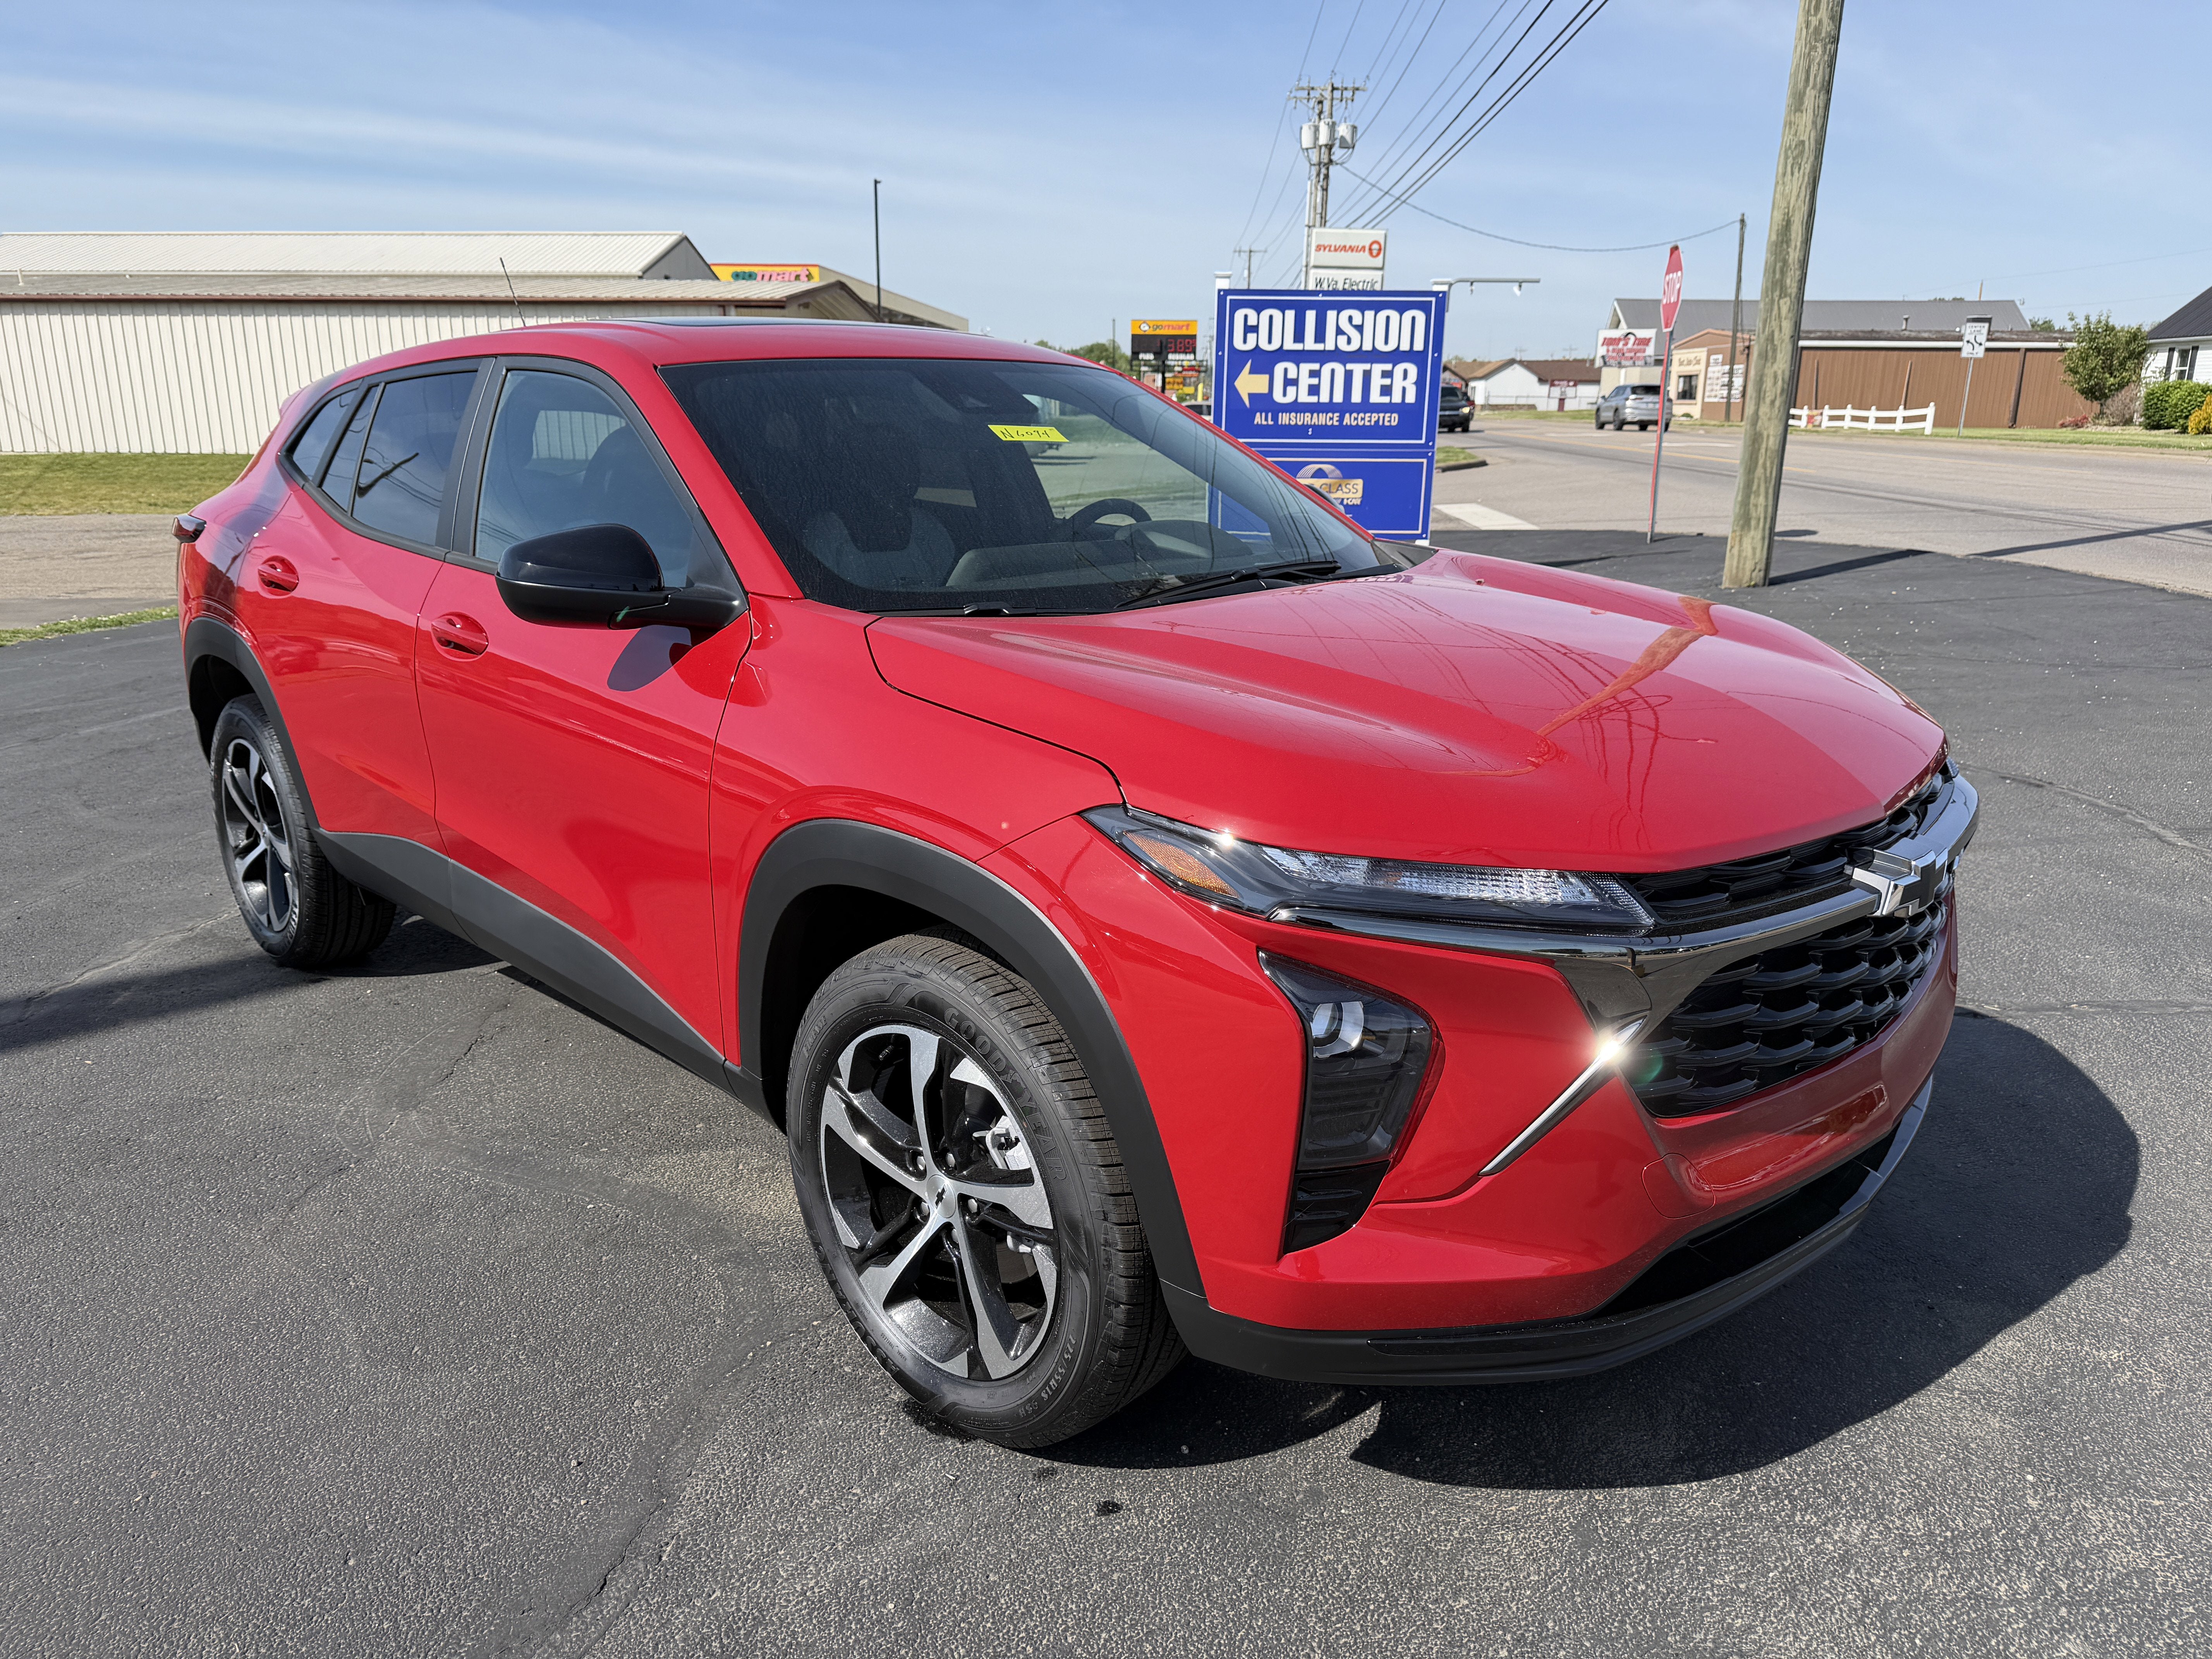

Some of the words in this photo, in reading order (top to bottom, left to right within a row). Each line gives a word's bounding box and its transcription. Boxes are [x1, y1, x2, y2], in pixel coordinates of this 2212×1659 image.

[1315, 244, 1366, 253] SYLVANIA
[1343, 277, 1378, 290] Electric
[1662, 271, 1681, 304] STOP
[1152, 323, 1190, 331] gomart
[1233, 308, 1426, 352] COLLISION
[1273, 361, 1418, 404] CENTER
[1254, 412, 1274, 425] ALL
[1278, 412, 1340, 426] INSURANCE
[1343, 413, 1399, 426] ACCEPTED
[1320, 483, 1358, 495] CLASS
[944, 1008, 1067, 1180] GOODYEAR
